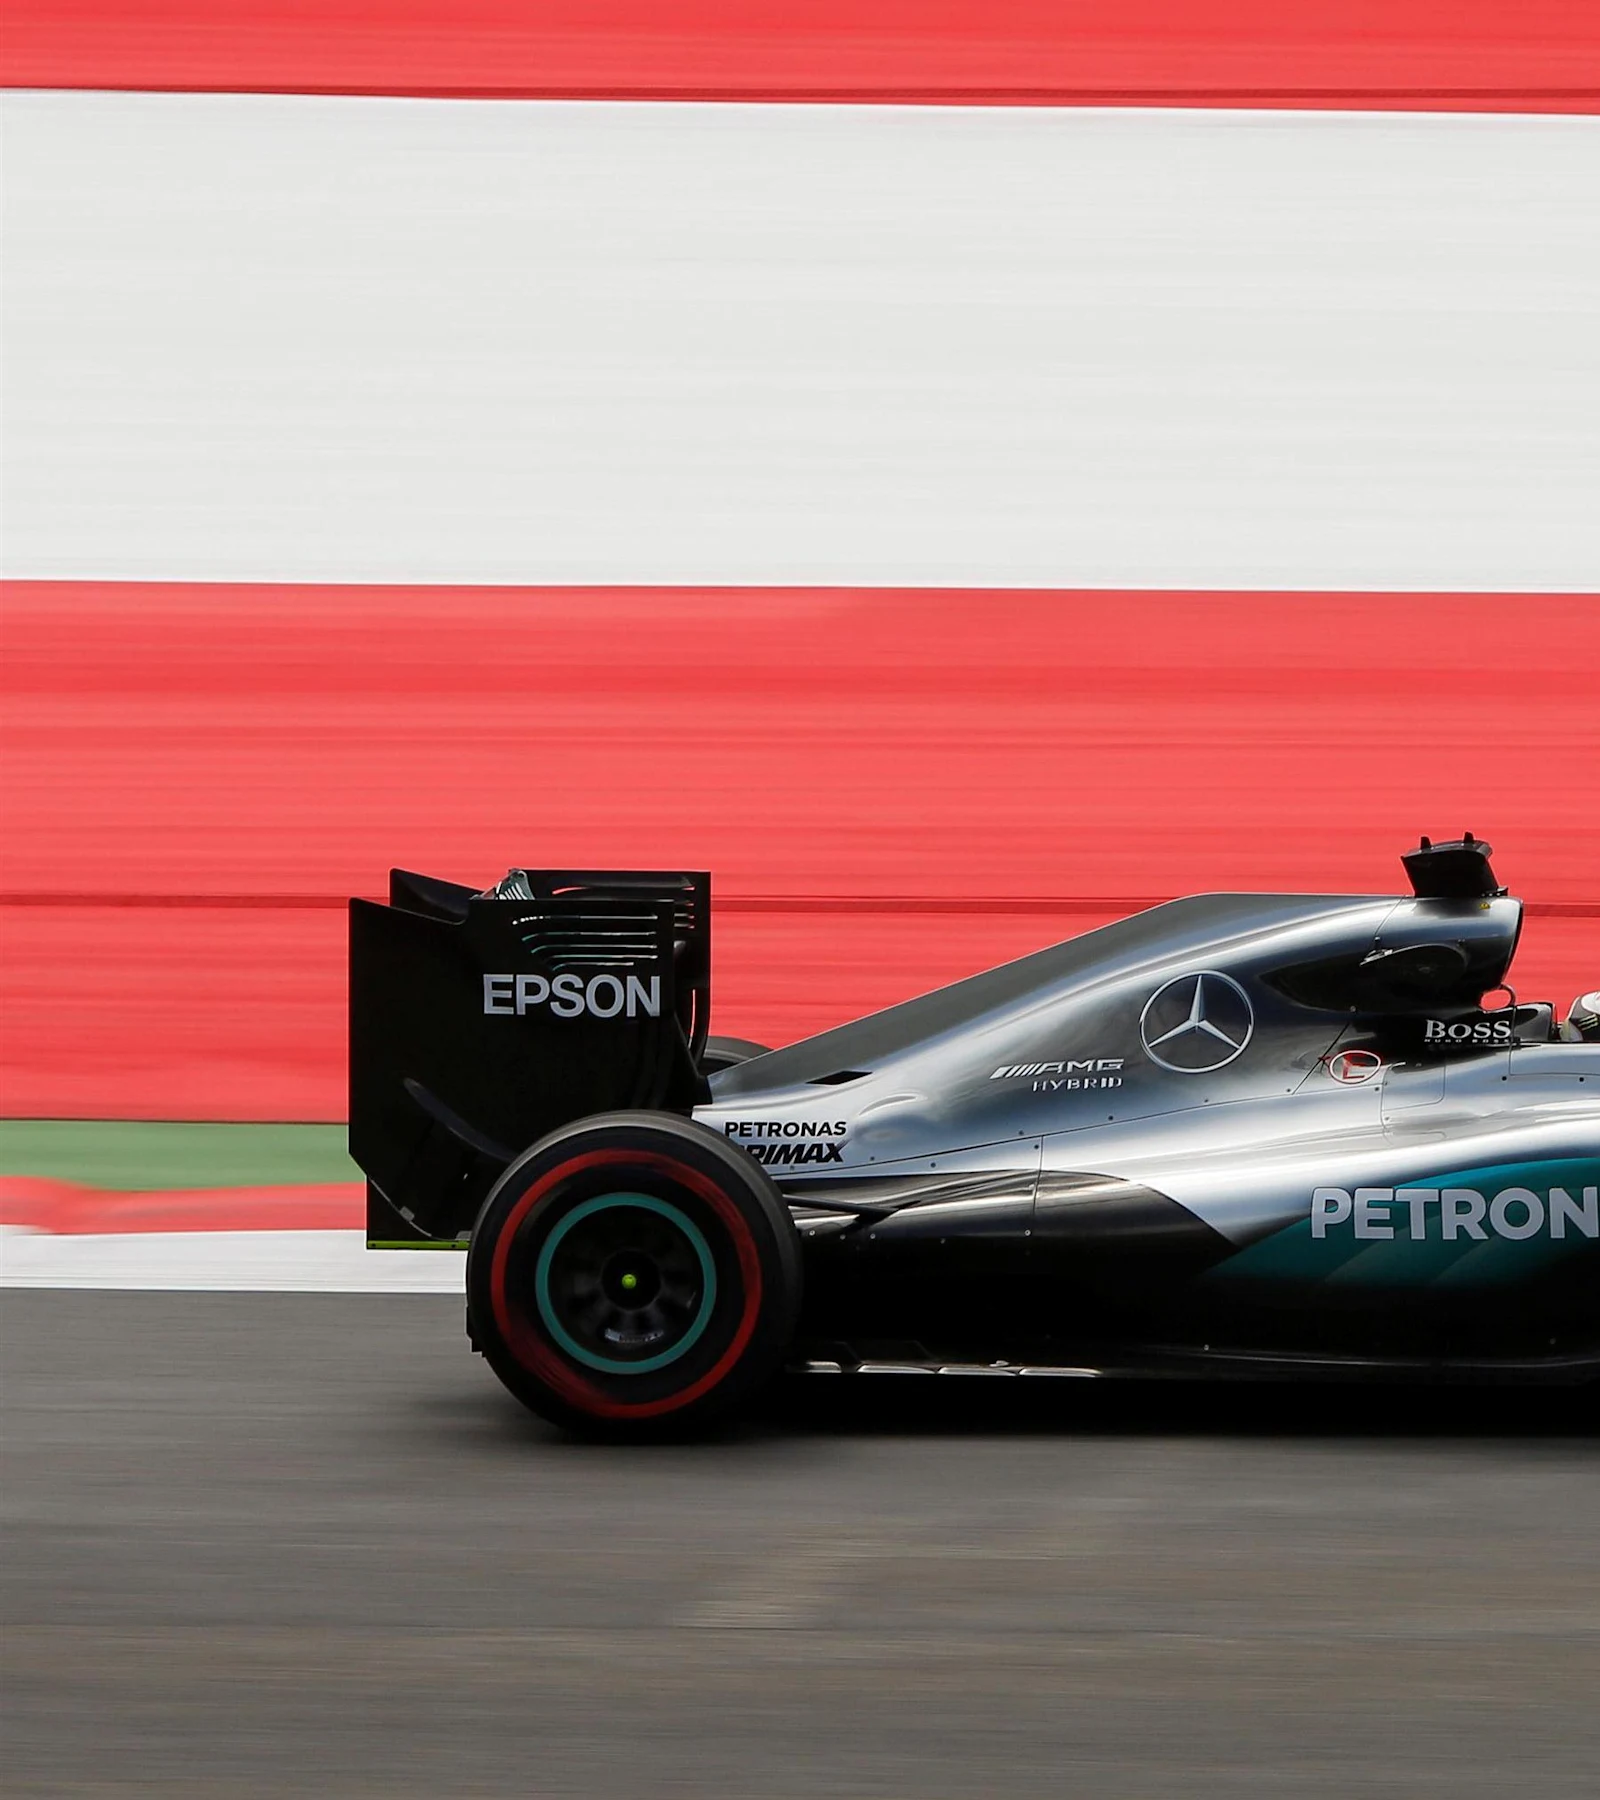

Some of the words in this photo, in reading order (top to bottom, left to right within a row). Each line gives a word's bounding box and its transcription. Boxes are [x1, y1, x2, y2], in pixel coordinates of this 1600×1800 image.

[483, 974, 660, 1018] EPSON
[1425, 1019, 1511, 1038] BOSS
[1032, 1077, 1122, 1092] HYBRID
[725, 1121, 847, 1137] PETRONAS
[740, 1139, 852, 1165] RIMAX
